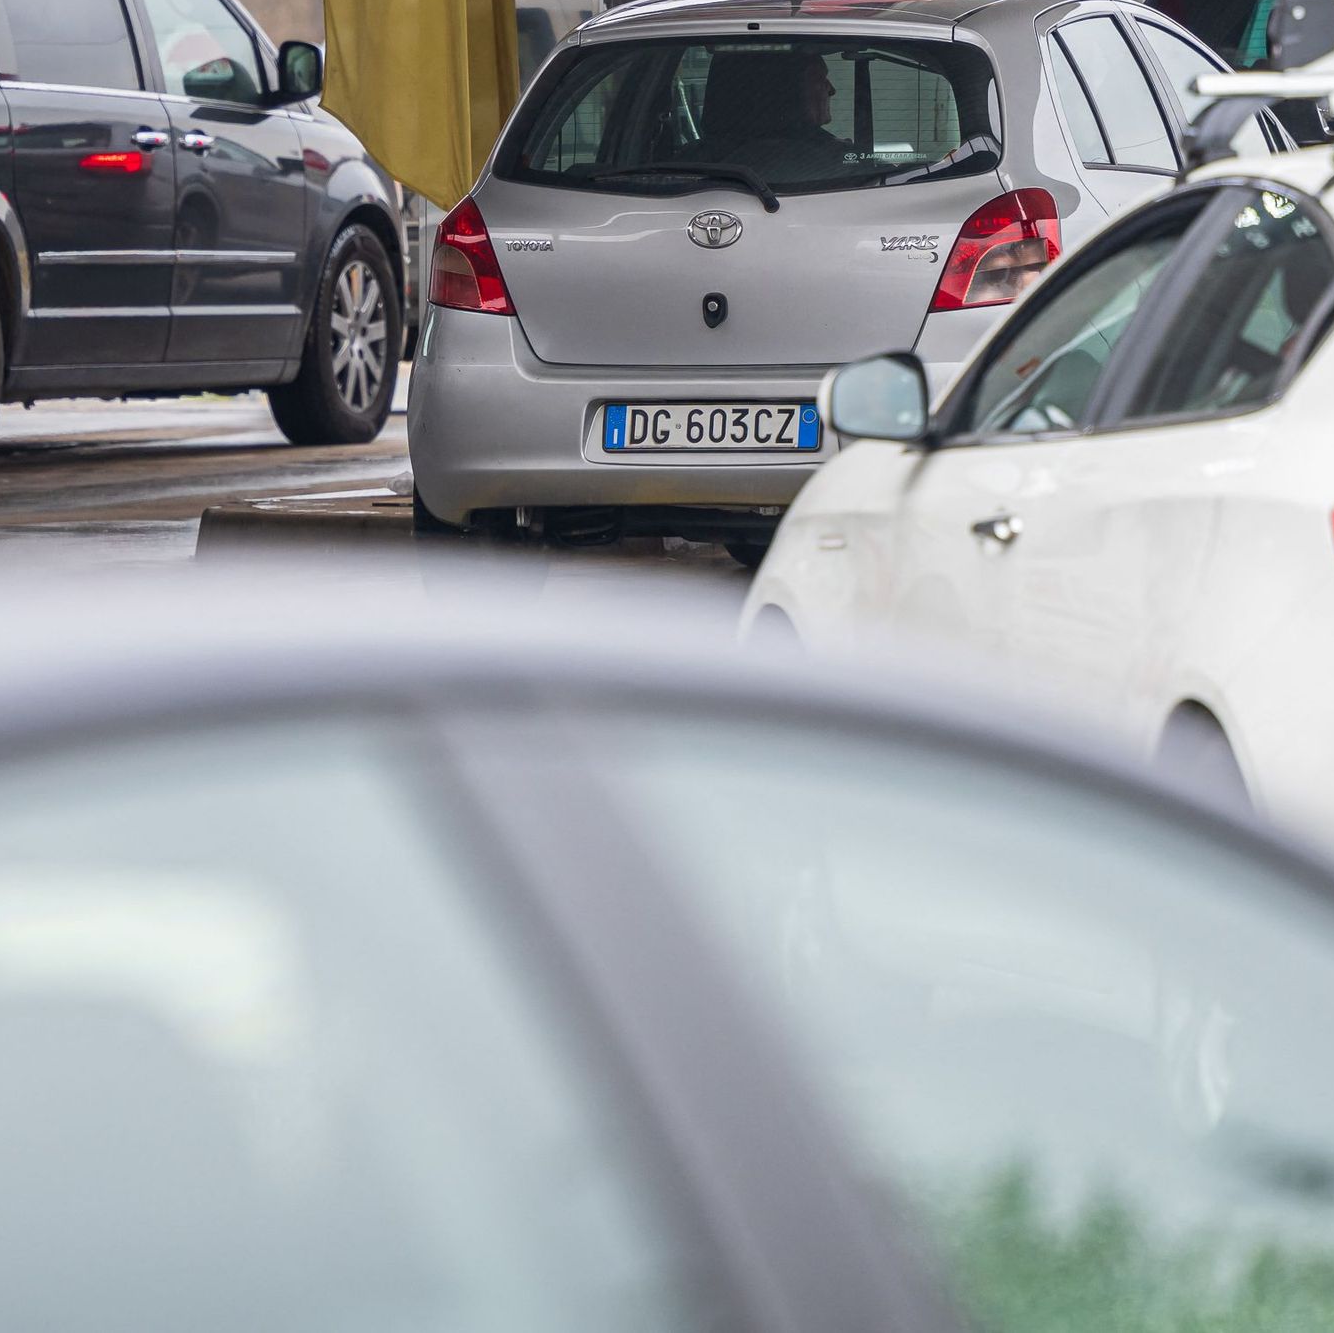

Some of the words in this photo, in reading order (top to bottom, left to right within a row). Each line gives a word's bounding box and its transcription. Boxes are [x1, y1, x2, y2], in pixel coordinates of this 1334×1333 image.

[505, 239, 555, 251] TOYOTA
[630, 409, 671, 444] DG
[686, 408, 796, 444] 603CZ
